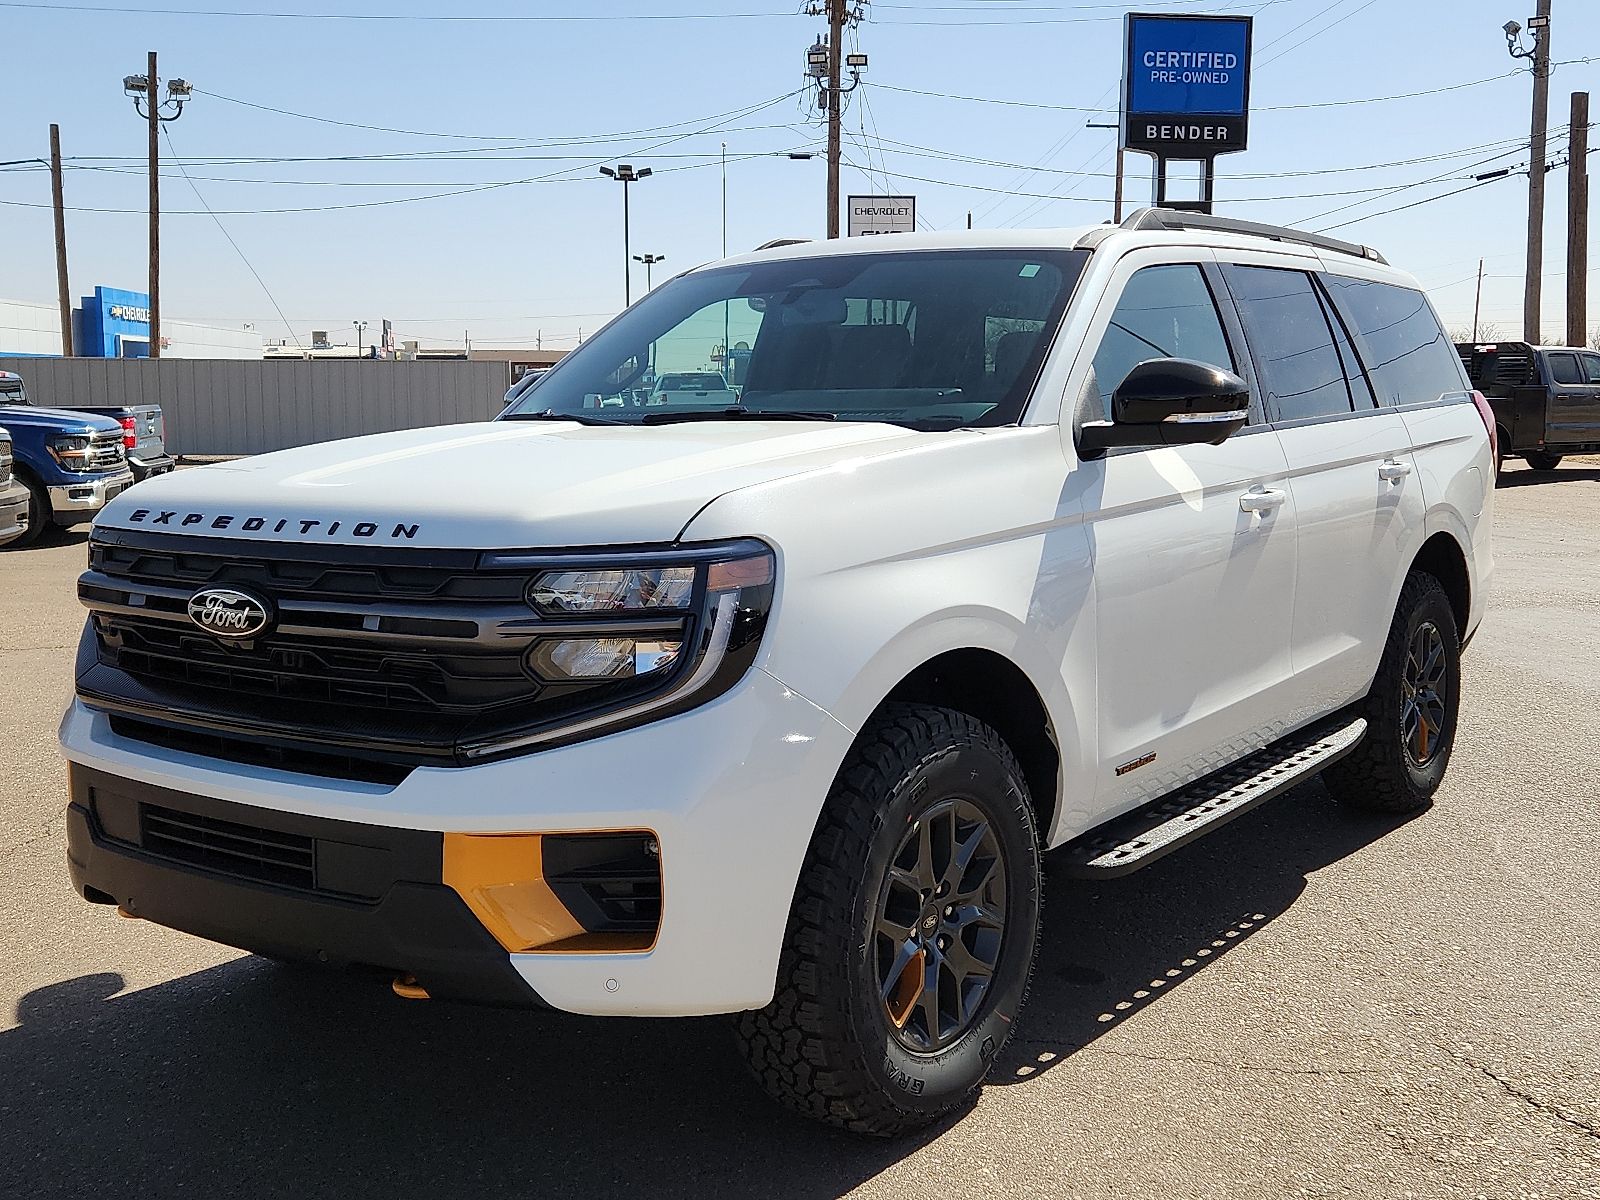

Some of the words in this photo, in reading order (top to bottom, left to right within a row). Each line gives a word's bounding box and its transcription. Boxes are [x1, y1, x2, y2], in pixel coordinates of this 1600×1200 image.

[1143, 51, 1237, 69] CERTIFIED
[1151, 70, 1229, 84] PRE-OWNED
[1146, 125, 1229, 140] BENDER
[854, 207, 910, 216] CHEVROLET
[122, 306, 150, 322] CHEVROLE
[129, 509, 420, 538] EXPEDITION
[201, 594, 250, 630] Ford
